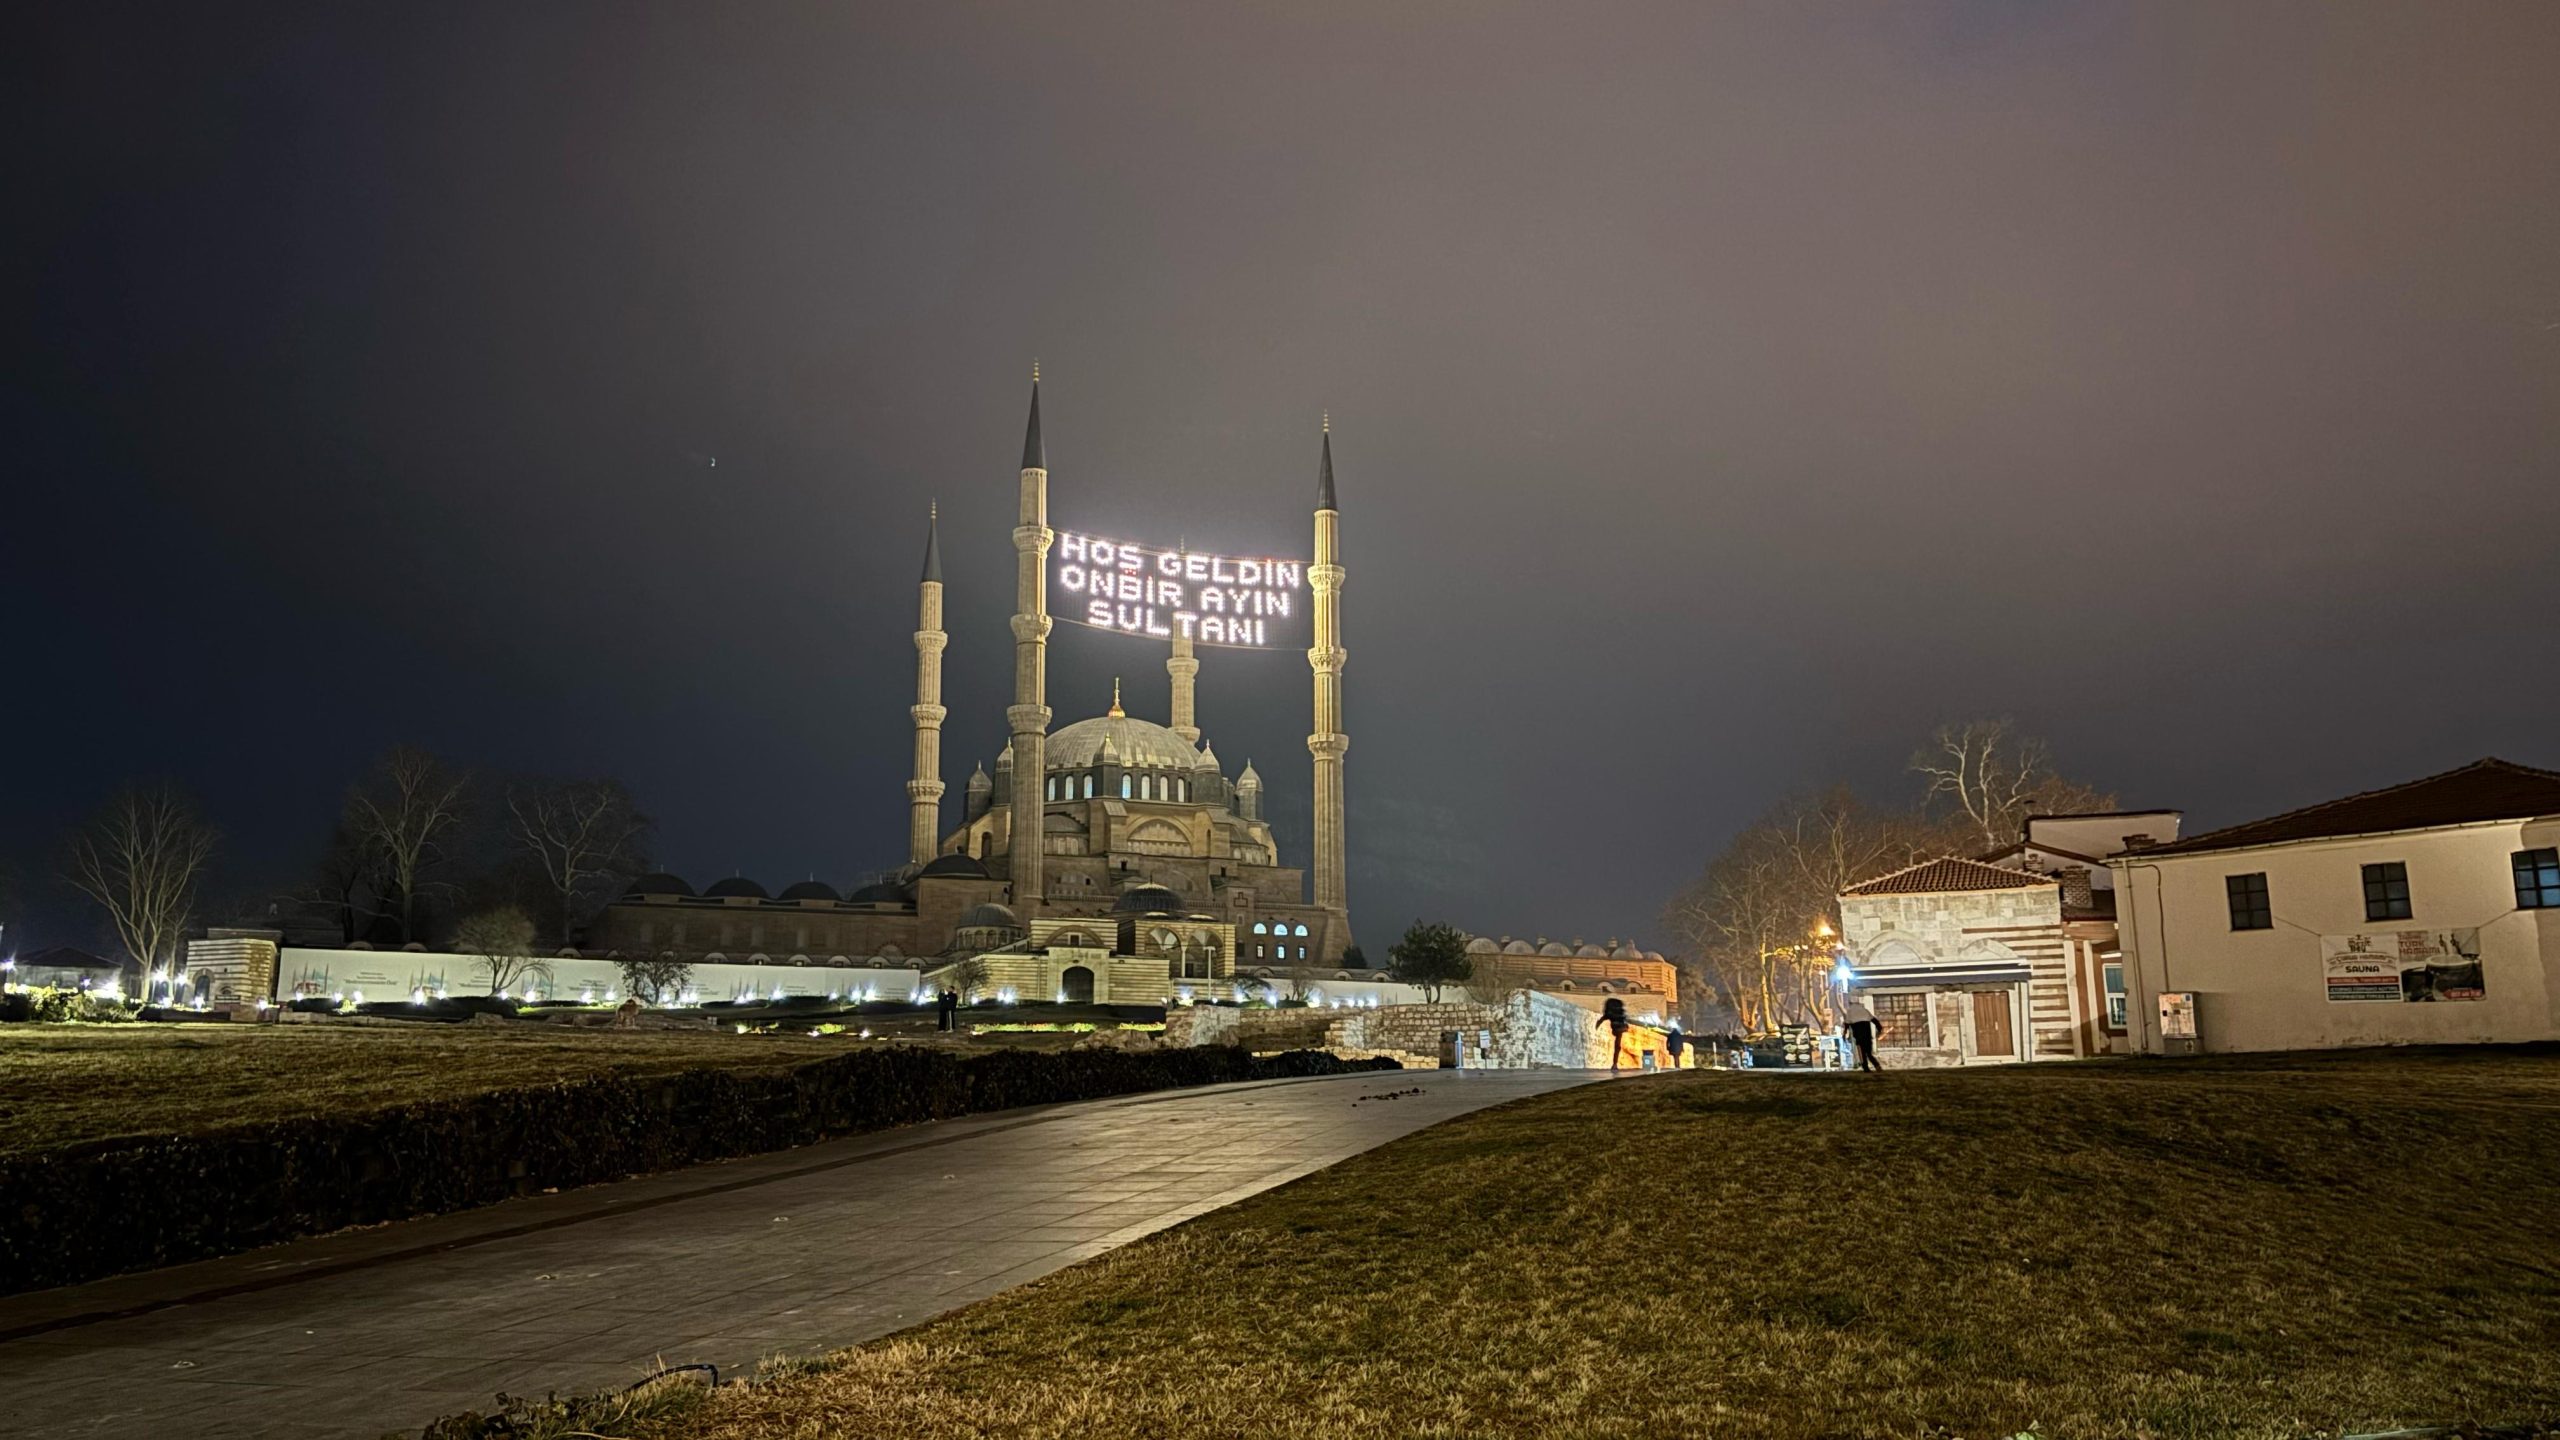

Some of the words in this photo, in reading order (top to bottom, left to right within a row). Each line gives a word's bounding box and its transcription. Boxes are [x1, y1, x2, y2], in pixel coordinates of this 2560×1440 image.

[1200, 586, 1291, 617] AYIN
[1087, 600, 1265, 645] SULTANI
[2345, 965, 2380, 973] SAUNA
